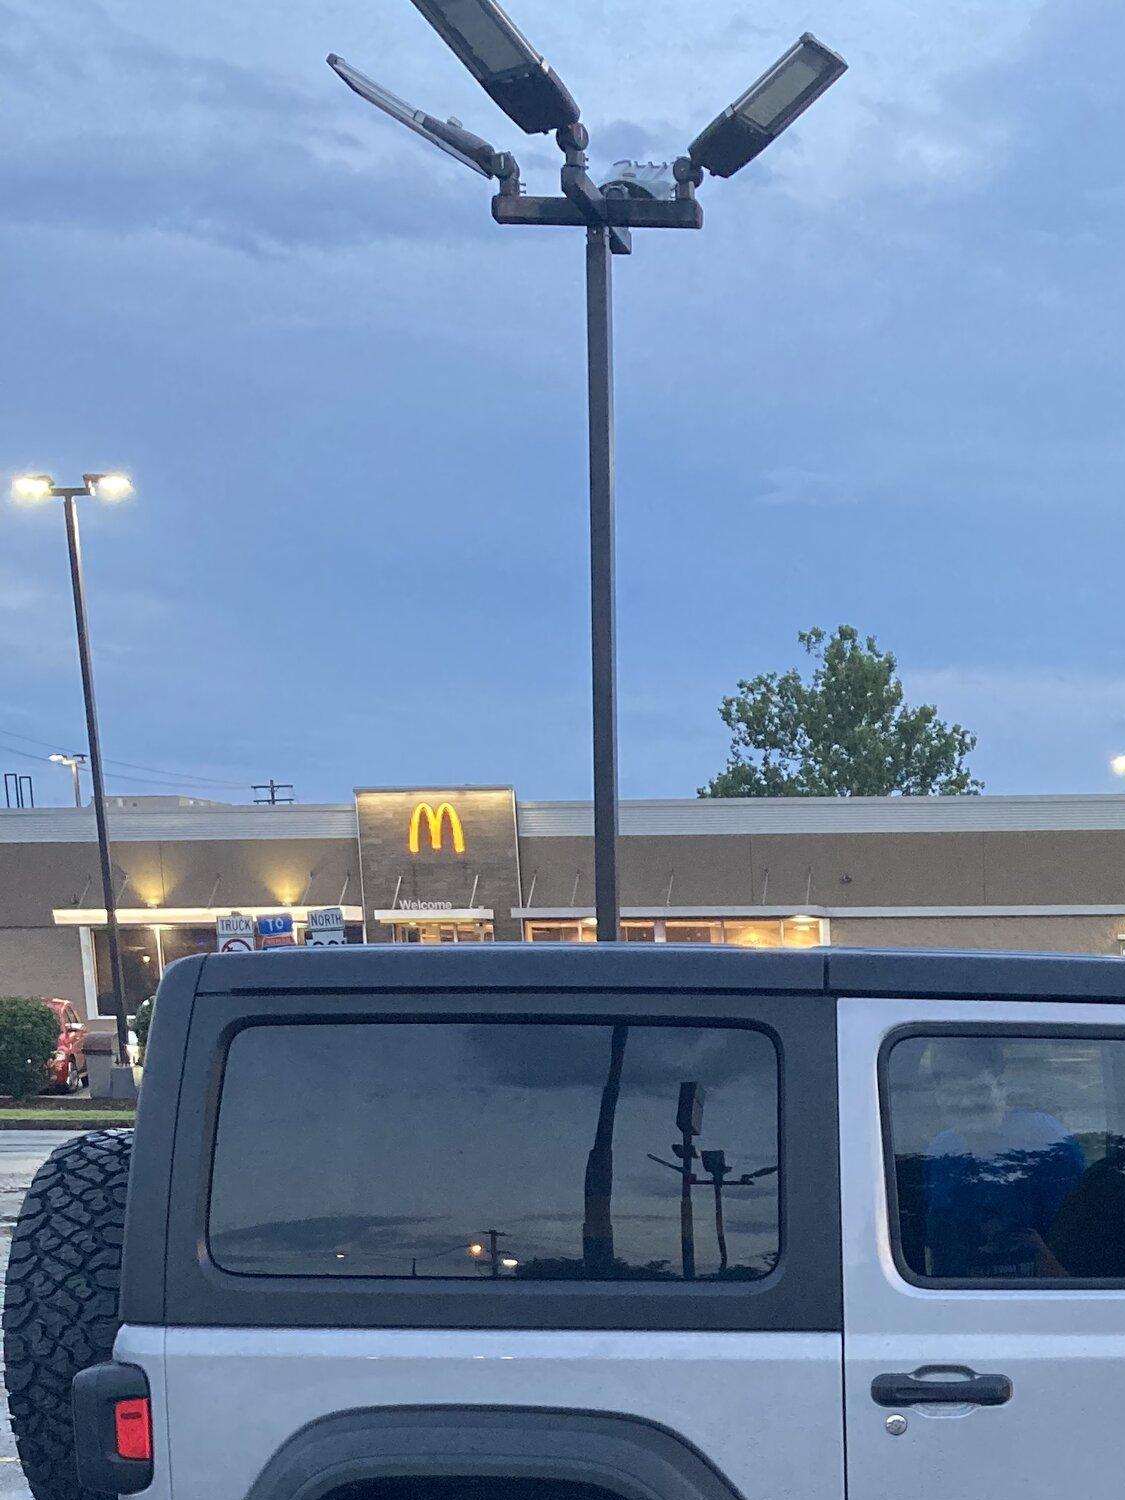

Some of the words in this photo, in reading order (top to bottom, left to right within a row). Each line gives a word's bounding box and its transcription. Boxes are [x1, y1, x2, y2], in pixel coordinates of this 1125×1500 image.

[399, 900, 452, 910] Welcome
[220, 919, 251, 931] TRUCK
[265, 917, 284, 931] TO
[310, 913, 342, 927] NORTH
